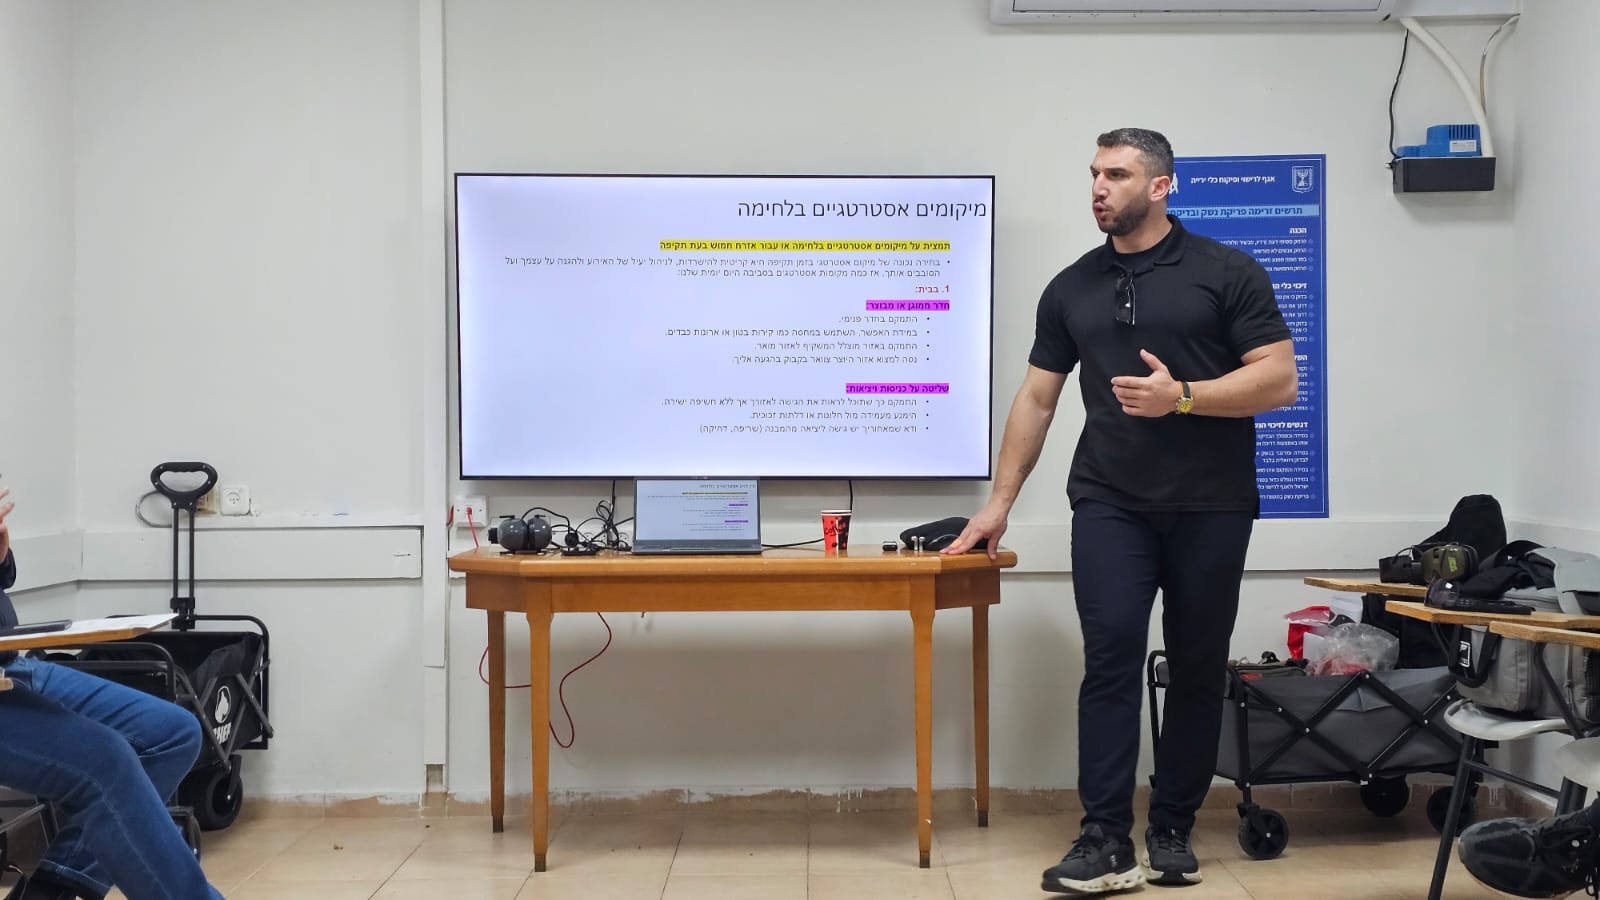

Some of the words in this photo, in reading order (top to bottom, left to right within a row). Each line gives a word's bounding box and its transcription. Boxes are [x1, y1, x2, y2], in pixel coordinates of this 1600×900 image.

[1207, 176, 1218, 184] כלי
[1219, 176, 1240, 185] ופיקוח
[1241, 175, 1262, 183] לרישוי
[738, 199, 806, 217] בלחימה
[813, 203, 909, 217] אסטרטגיים
[916, 203, 986, 221] מיקומים
[1248, 207, 1272, 216] זרימה
[1275, 207, 1303, 215] תרשים
[1201, 208, 1218, 218] נשק
[1220, 208, 1246, 218] פריקת
[661, 243, 687, 252] תקיפה
[792, 240, 824, 250] בלחימה
[875, 243, 907, 252] מיקומים
[909, 240, 920, 250] על
[505, 255, 518, 265] ועל
[521, 257, 542, 267] עצמך
[545, 255, 555, 265] על
[557, 255, 584, 265] ולהגנה
[586, 257, 614, 265] האירוע
[616, 255, 629, 265] של
[630, 255, 646, 265] יעיל
[648, 256, 673, 265] לניהול
[720, 258, 748, 268] קריטית
[750, 258, 765, 266] היא
[767, 258, 793, 268] תקיפה
[796, 258, 814, 268] בזמן
[816, 258, 851, 266] אסטרטגי
[853, 258, 876, 268] מיקום
[878, 256, 891, 266] של
[700, 269, 721, 277] יומית
[723, 269, 740, 277] היום
[742, 269, 775, 277] בסביבה
[819, 269, 848, 279] מקומות
[850, 269, 868, 277] כמה
[870, 269, 880, 277] אז
[907, 269, 940, 277] הסובבים
[915, 285, 939, 293] בבית:
[908, 302, 930, 311] ממוגן
[888, 316, 918, 325] התמקם
[665, 329, 691, 337] כבדים.
[693, 329, 719, 337] ארונות
[722, 329, 730, 337] או
[733, 329, 749, 339] בטון
[751, 329, 774, 339] קירות
[776, 329, 789, 337] כמו
[792, 329, 821, 337] במחסה
[823, 329, 856, 337] השתמש
[892, 329, 918, 337] במידת
[778, 341, 800, 350] לאזור
[803, 343, 835, 352] המשקיף
[837, 341, 860, 350] מוצלל
[888, 343, 919, 352] התמקם
[783, 356, 808, 366] בקבוק
[876, 354, 900, 363] למצוא
[909, 383, 919, 392] על
[922, 383, 949, 392] שליטה
[719, 396, 734, 406] ללא
[736, 399, 747, 408] אך
[750, 396, 776, 408] לאזורך
[821, 396, 845, 406] לראות
[847, 396, 873, 406] שתוכל
[874, 399, 885, 408] כך
[887, 399, 917, 408] התמקם
[778, 410, 804, 419] דלתות
[817, 410, 843, 419] חלונות
[844, 410, 858, 419] מול
[699, 424, 728, 436] דחיקה)
[764, 425, 797, 433] מהמבנה
[800, 423, 826, 433] ליציאה
[828, 425, 848, 433] גישה
[849, 425, 860, 433] יש
[861, 425, 902, 435] שמאחוריך
[903, 425, 917, 433] ודא
